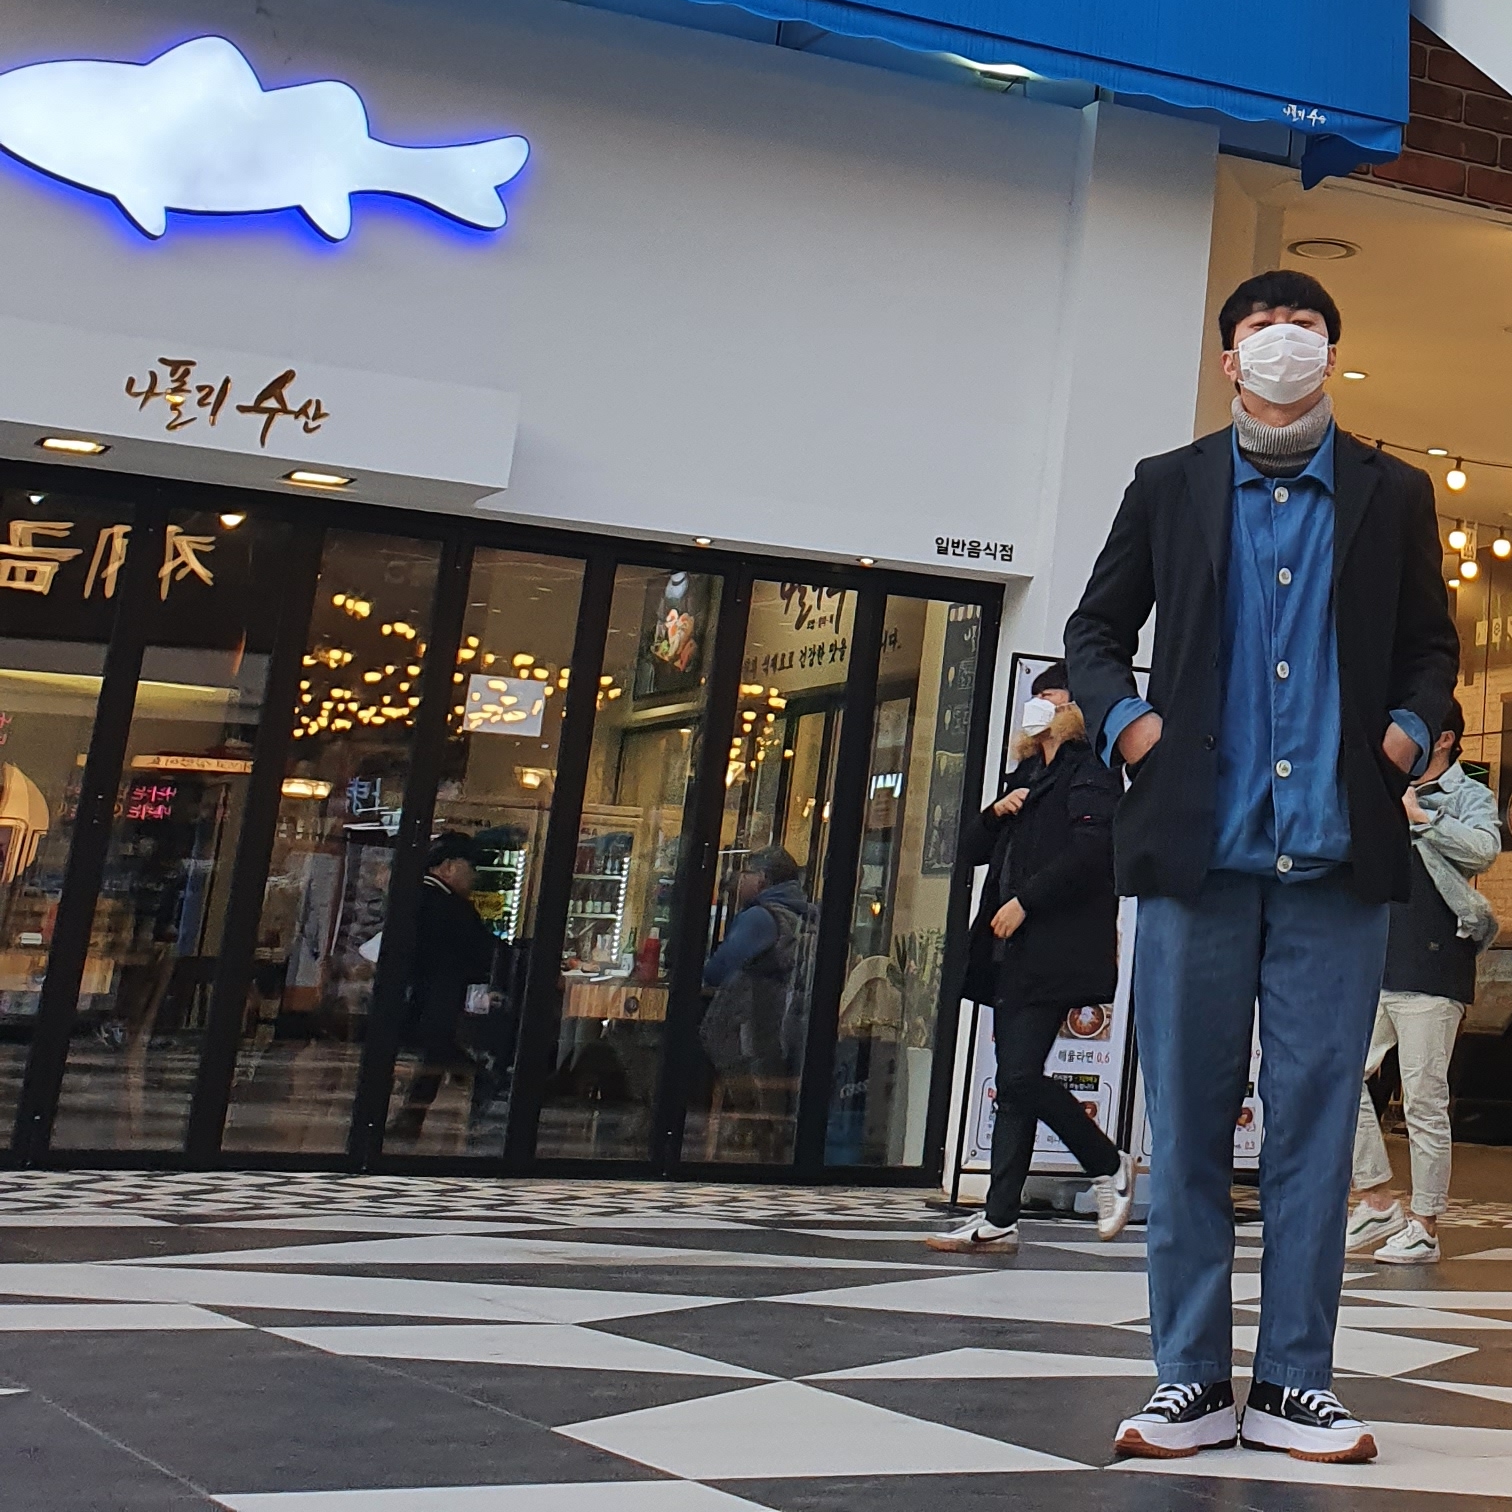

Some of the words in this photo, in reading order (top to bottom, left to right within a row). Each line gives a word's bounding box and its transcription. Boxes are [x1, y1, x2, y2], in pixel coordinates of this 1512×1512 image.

[124, 356, 232, 431] 나폴리
[235, 368, 331, 449] 수산
[934, 535, 1015, 563] 일반음식점
